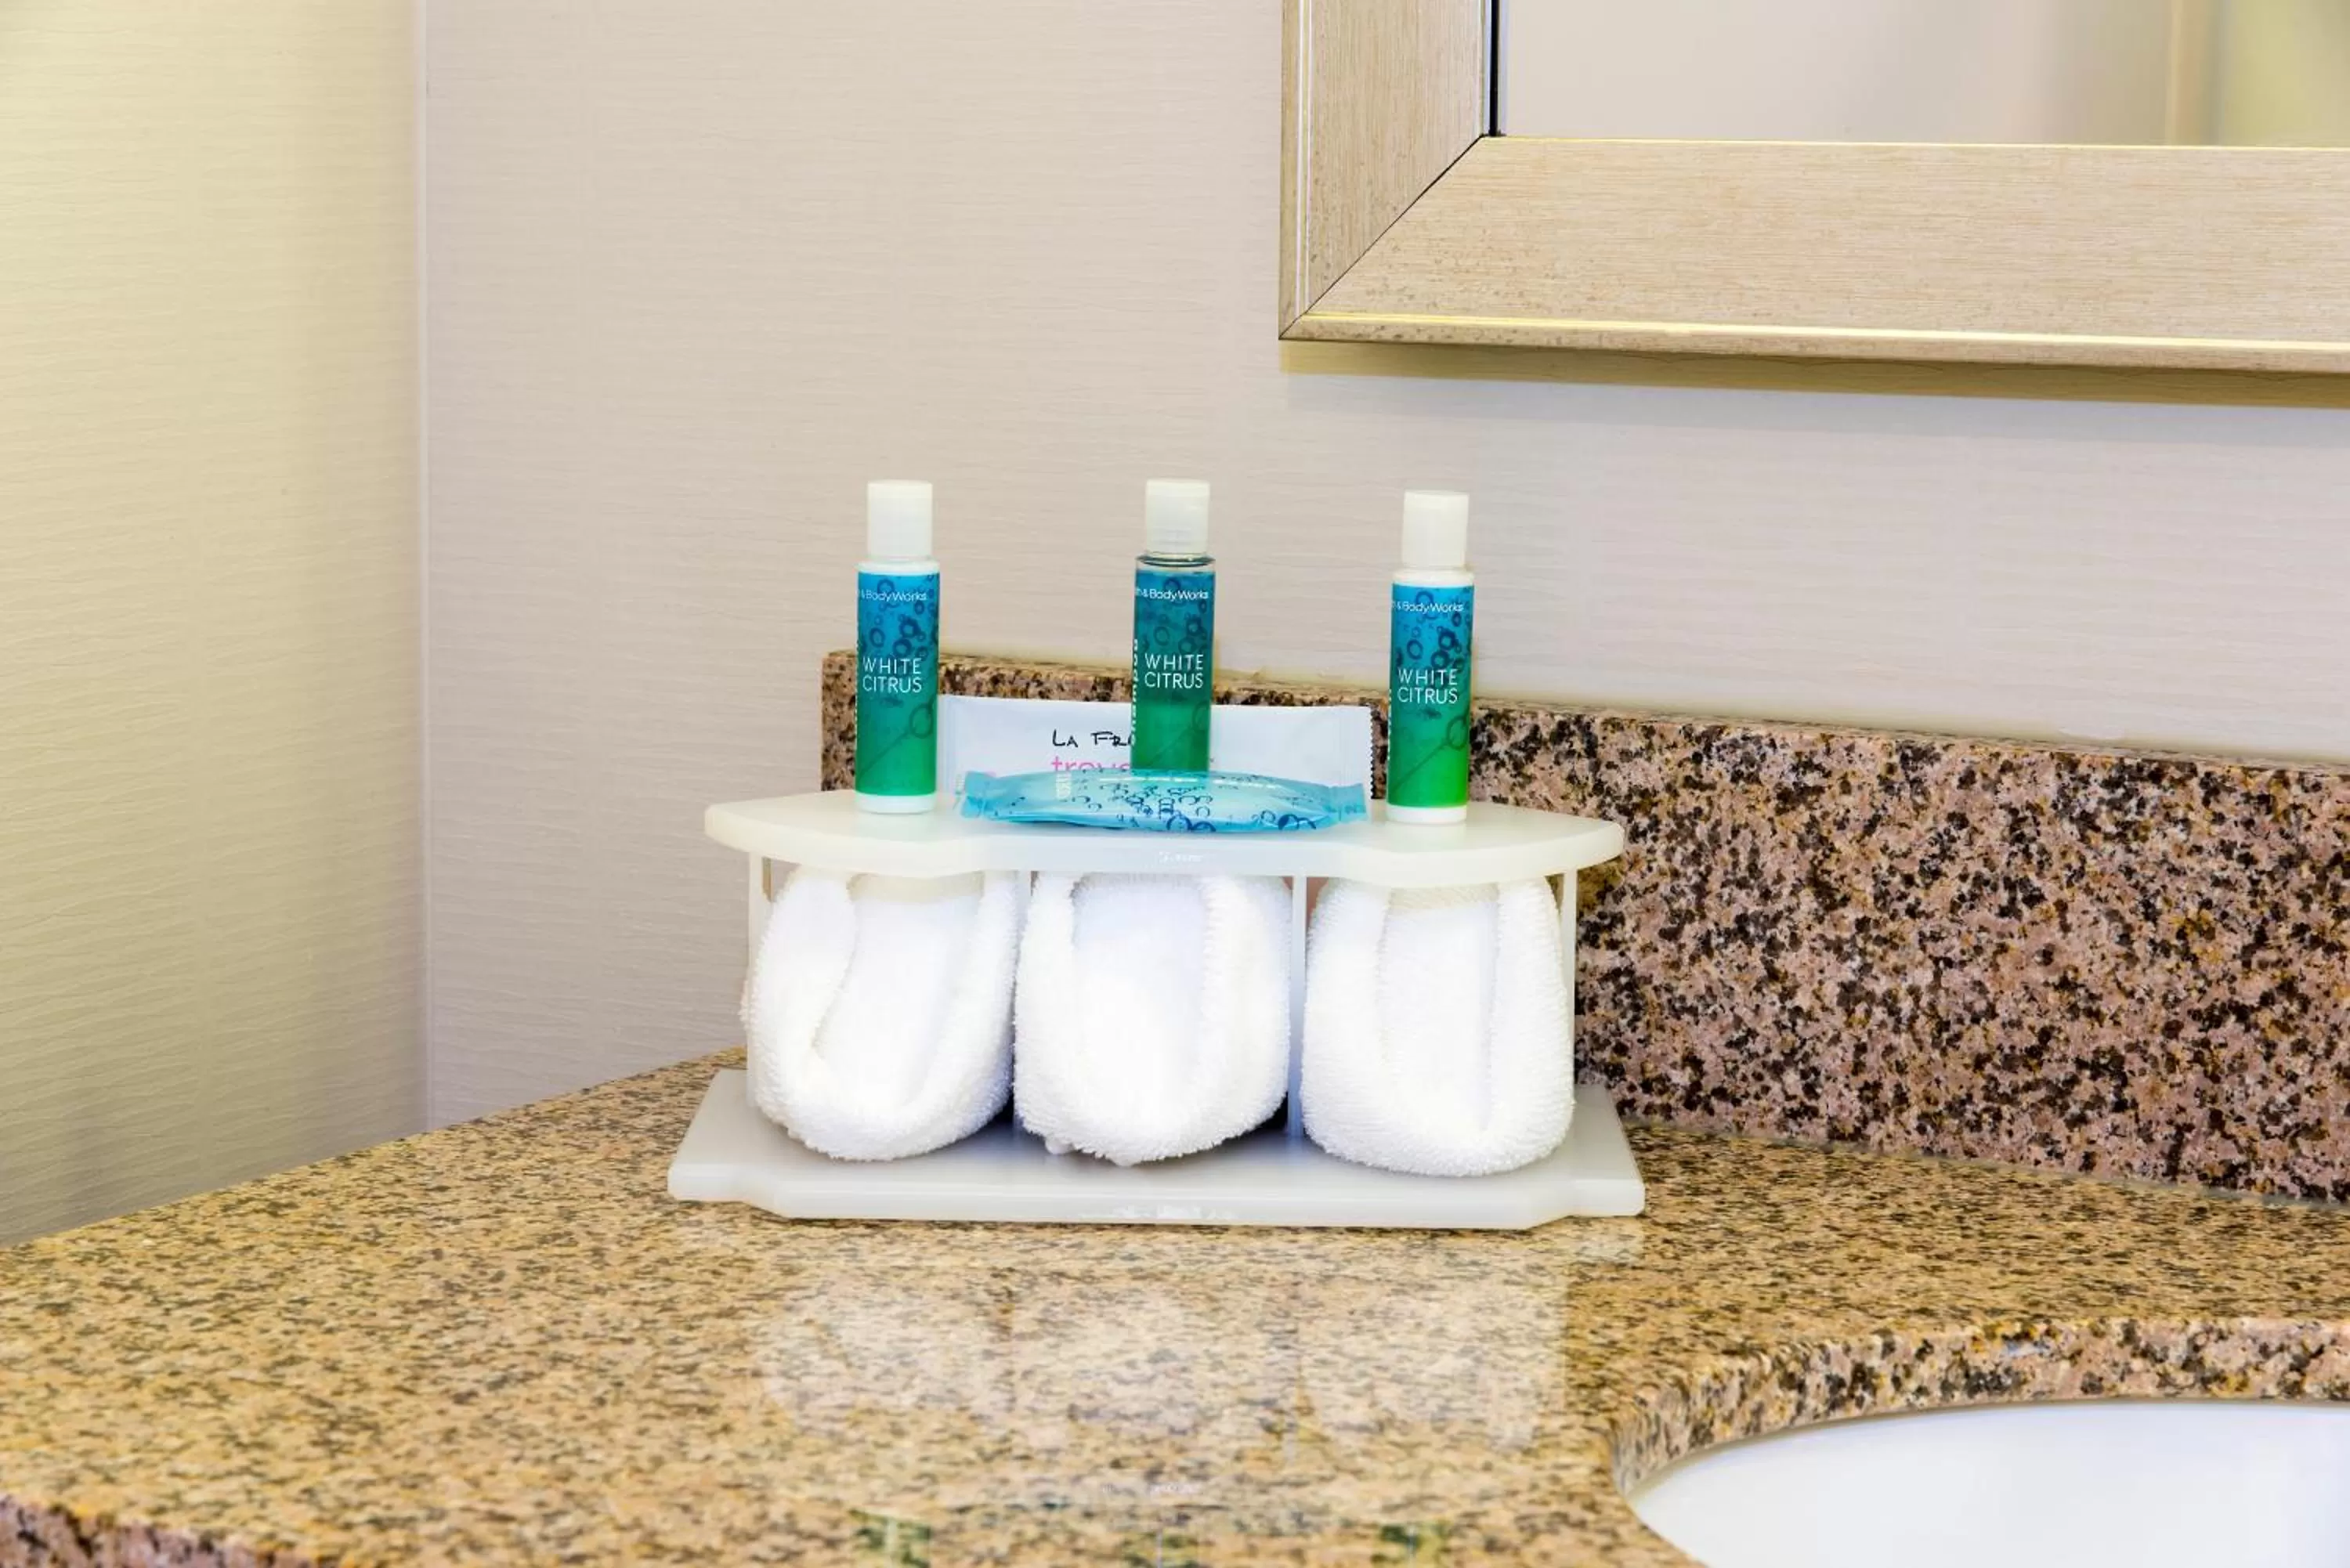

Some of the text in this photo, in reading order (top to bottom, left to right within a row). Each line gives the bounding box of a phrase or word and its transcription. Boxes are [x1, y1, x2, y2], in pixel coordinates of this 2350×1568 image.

[862, 656, 922, 674] WHITE
[1144, 653, 1204, 671] WHITE
[862, 675, 922, 693] CITRUS
[1144, 671, 1204, 688] CITRUS
[1397, 667, 1458, 685] WHITE
[1397, 686, 1458, 704] CITRUS
[1090, 731, 1132, 746] FR
